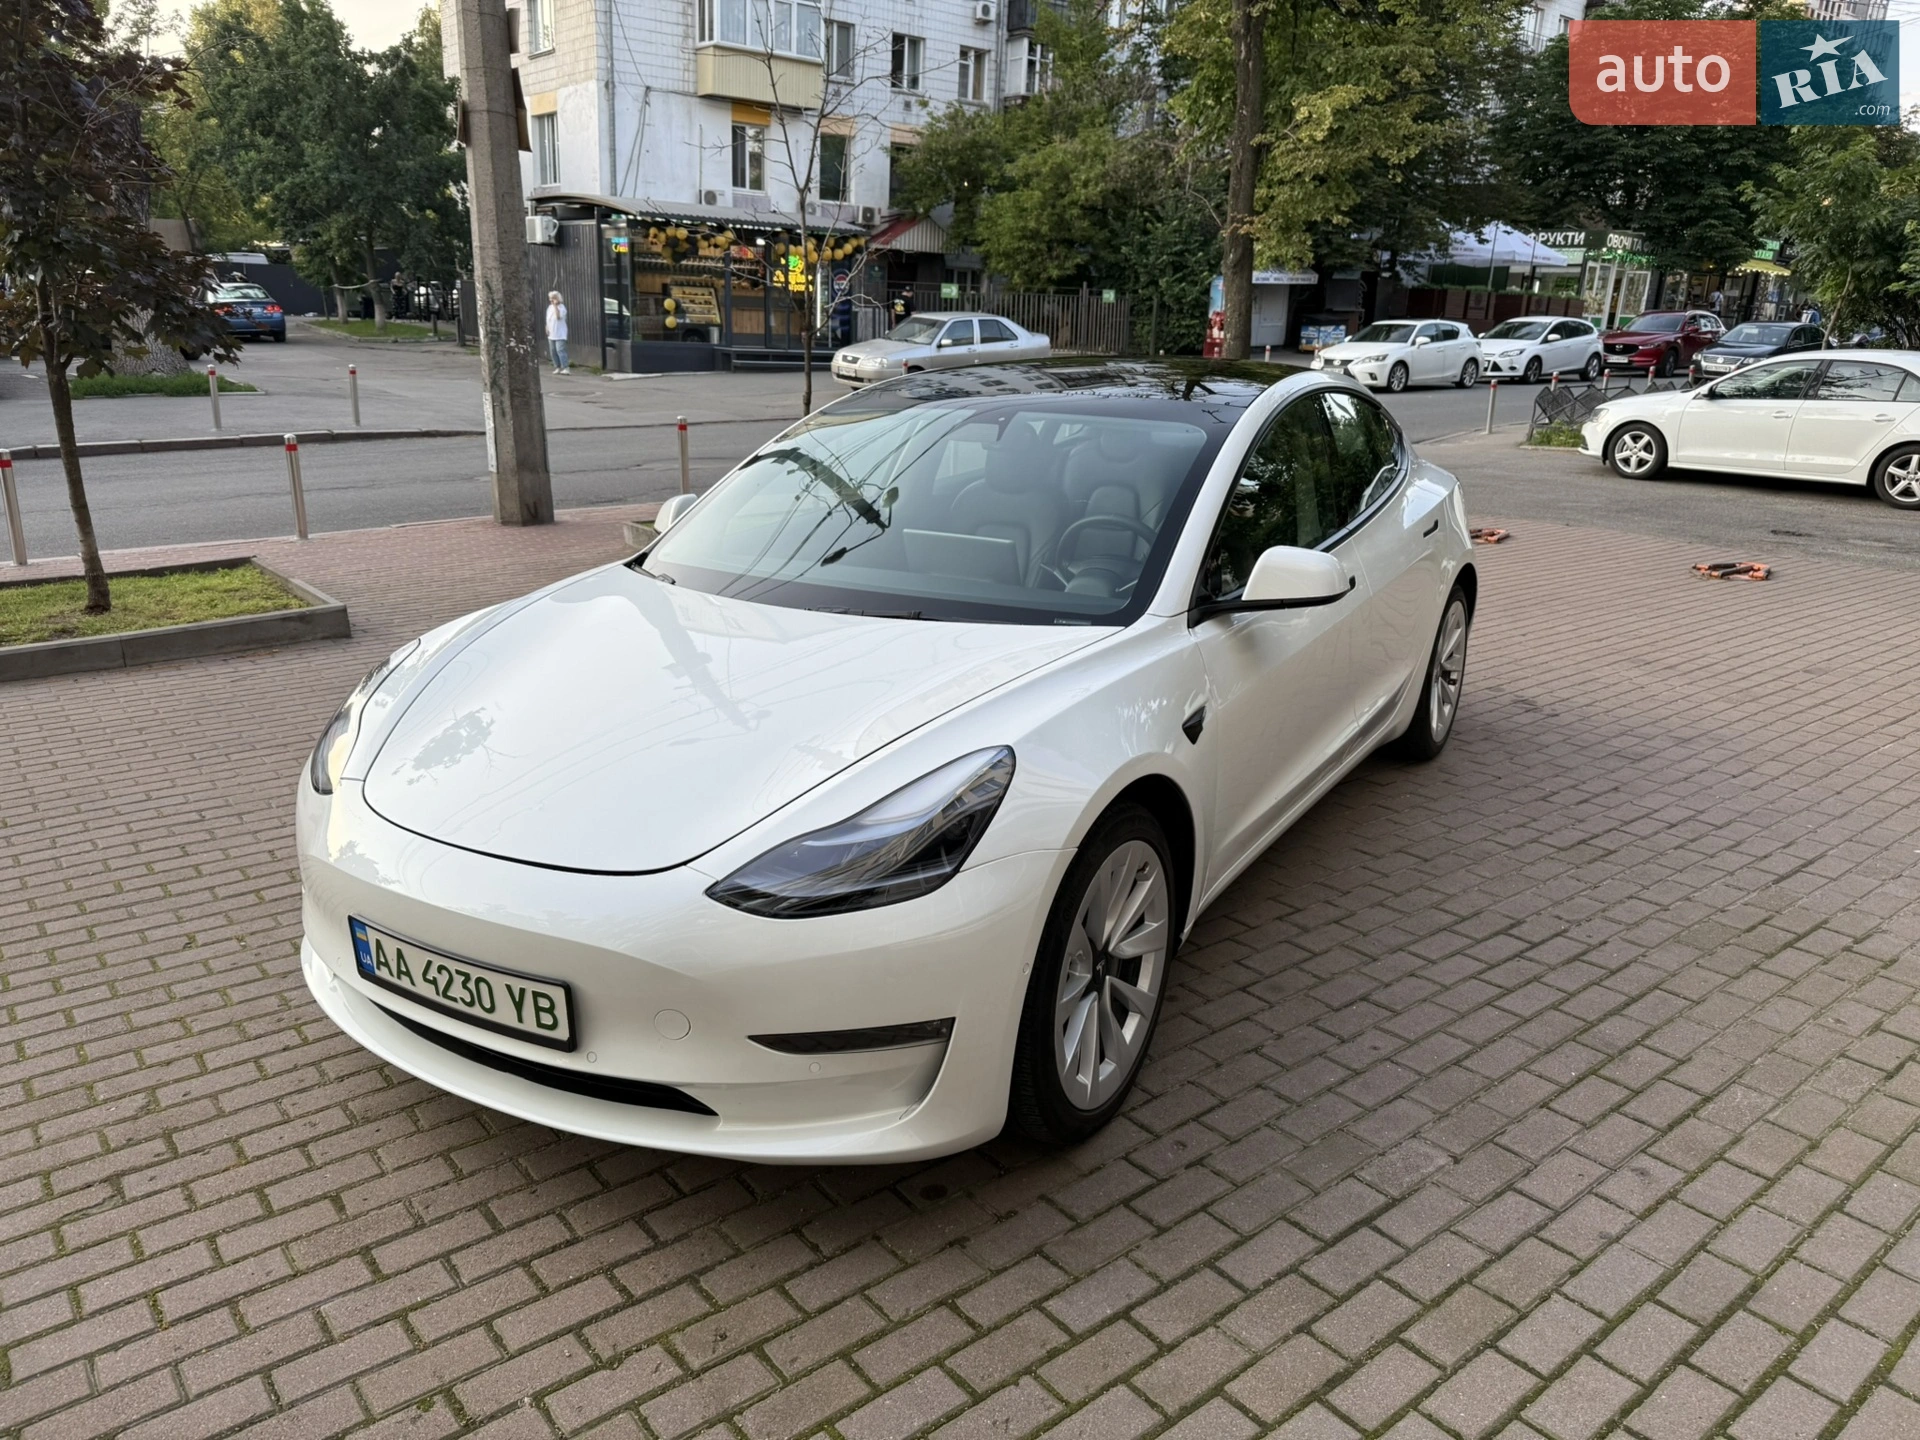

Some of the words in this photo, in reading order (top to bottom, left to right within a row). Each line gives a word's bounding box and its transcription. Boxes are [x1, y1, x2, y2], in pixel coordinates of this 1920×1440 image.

[1606, 233, 1633, 250] ОВОЧІ
[1633, 238, 1642, 252] ТА
[360, 951, 373, 966] UA
[375, 937, 416, 987] AA
[421, 959, 496, 1014] 4230
[504, 982, 559, 1031] YB
